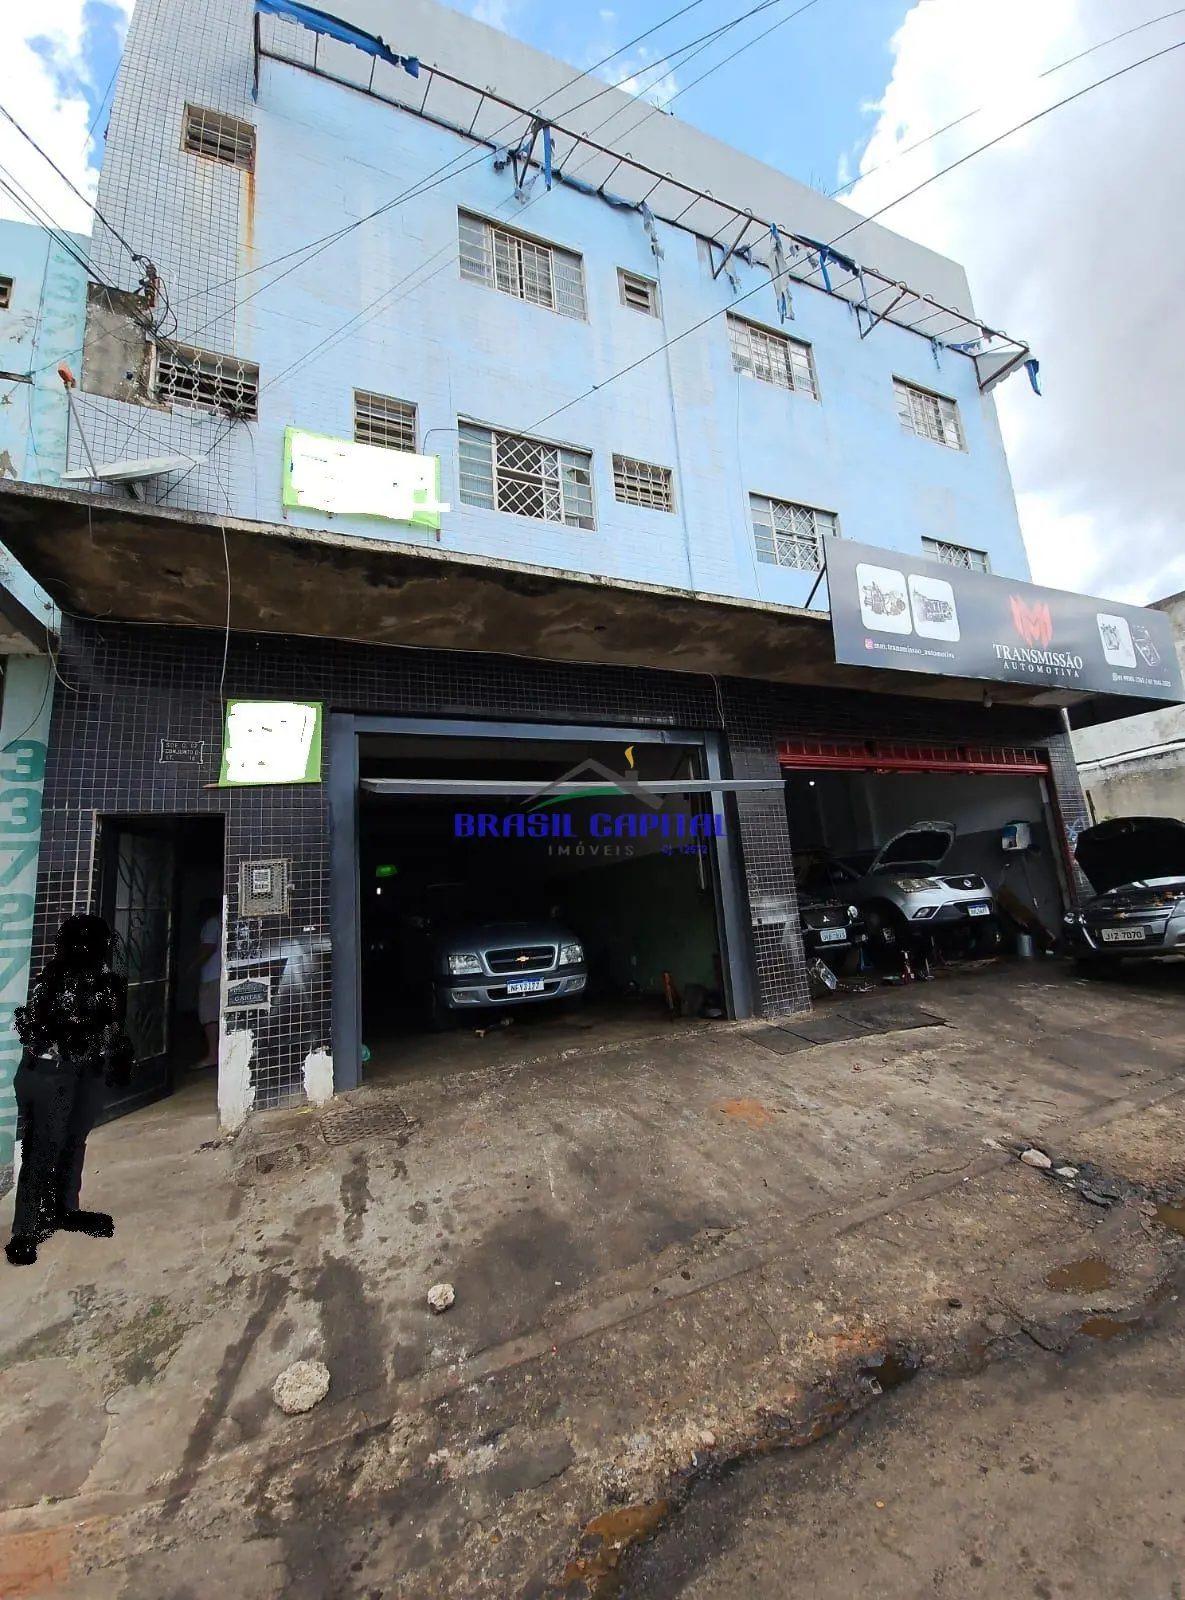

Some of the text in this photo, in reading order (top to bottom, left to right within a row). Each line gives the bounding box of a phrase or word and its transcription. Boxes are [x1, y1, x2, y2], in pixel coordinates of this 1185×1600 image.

[992, 643, 1084, 670] TRANSMISSÃO
[1003, 660, 1080, 678] AUTOMOTIVA
[1121, 931, 1142, 939] 7070
